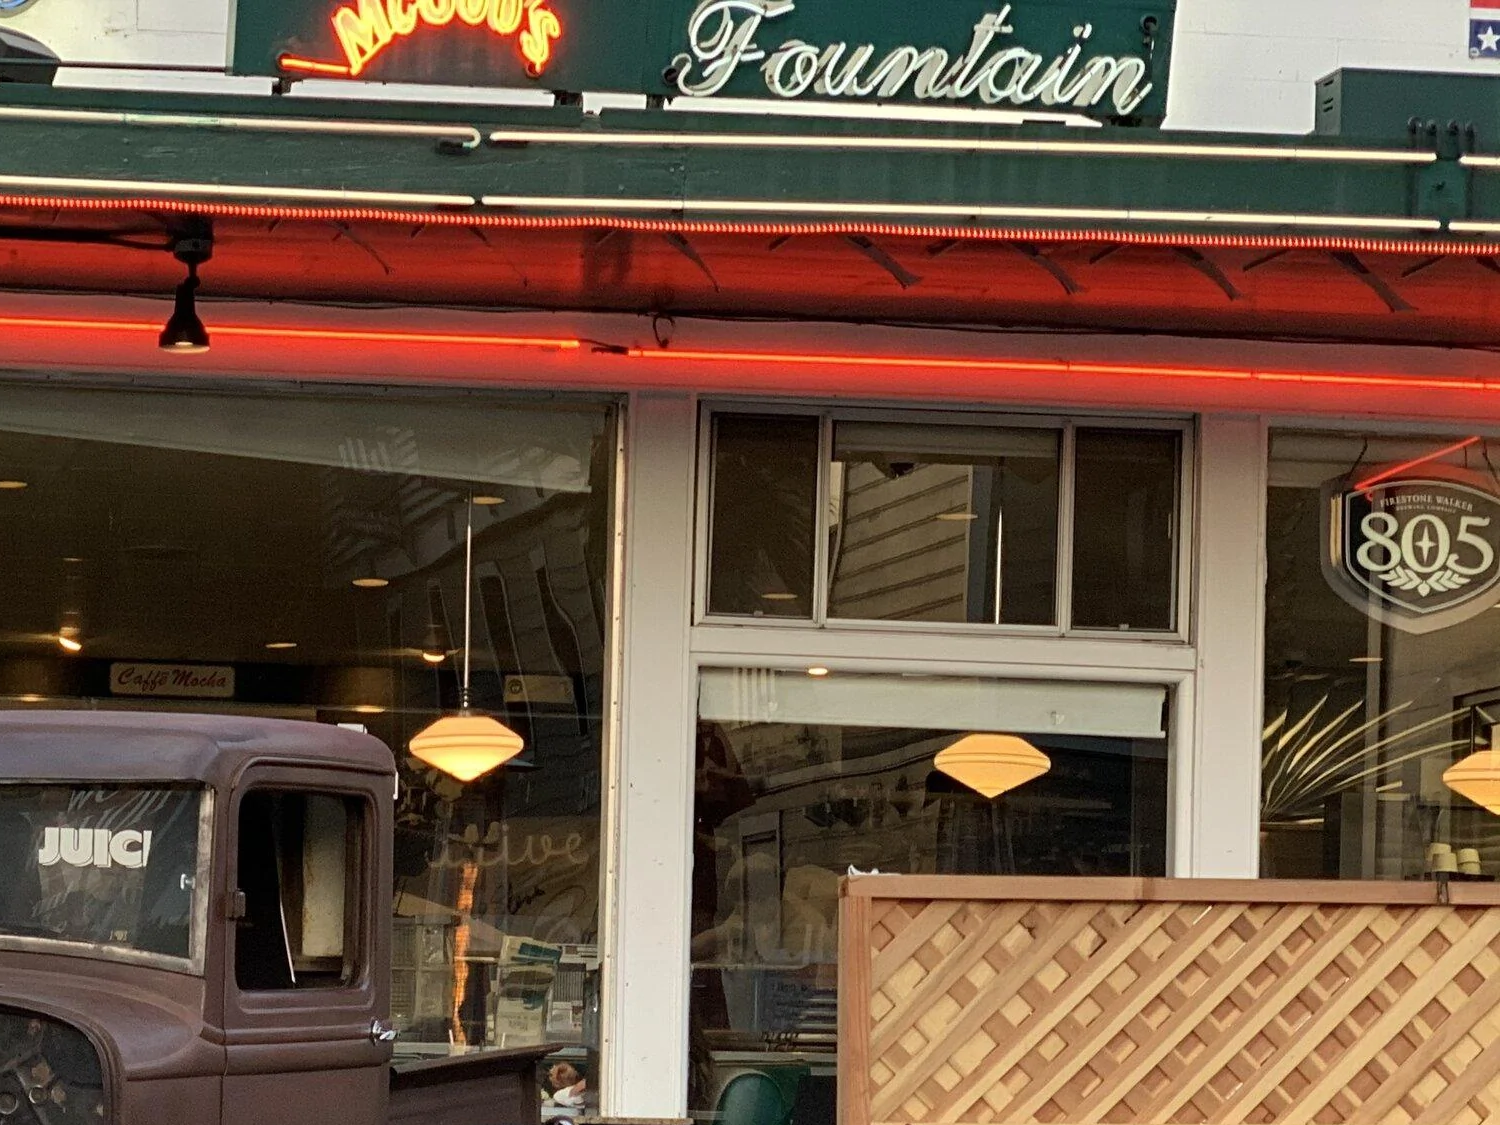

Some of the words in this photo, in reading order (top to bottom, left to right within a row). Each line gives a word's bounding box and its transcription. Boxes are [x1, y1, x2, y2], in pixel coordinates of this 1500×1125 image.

[671, 1, 1152, 115] Fountain
[1436, 495, 1474, 513] WALKER
[1356, 511, 1494, 575] 805
[172, 668, 227, 688] Mocha
